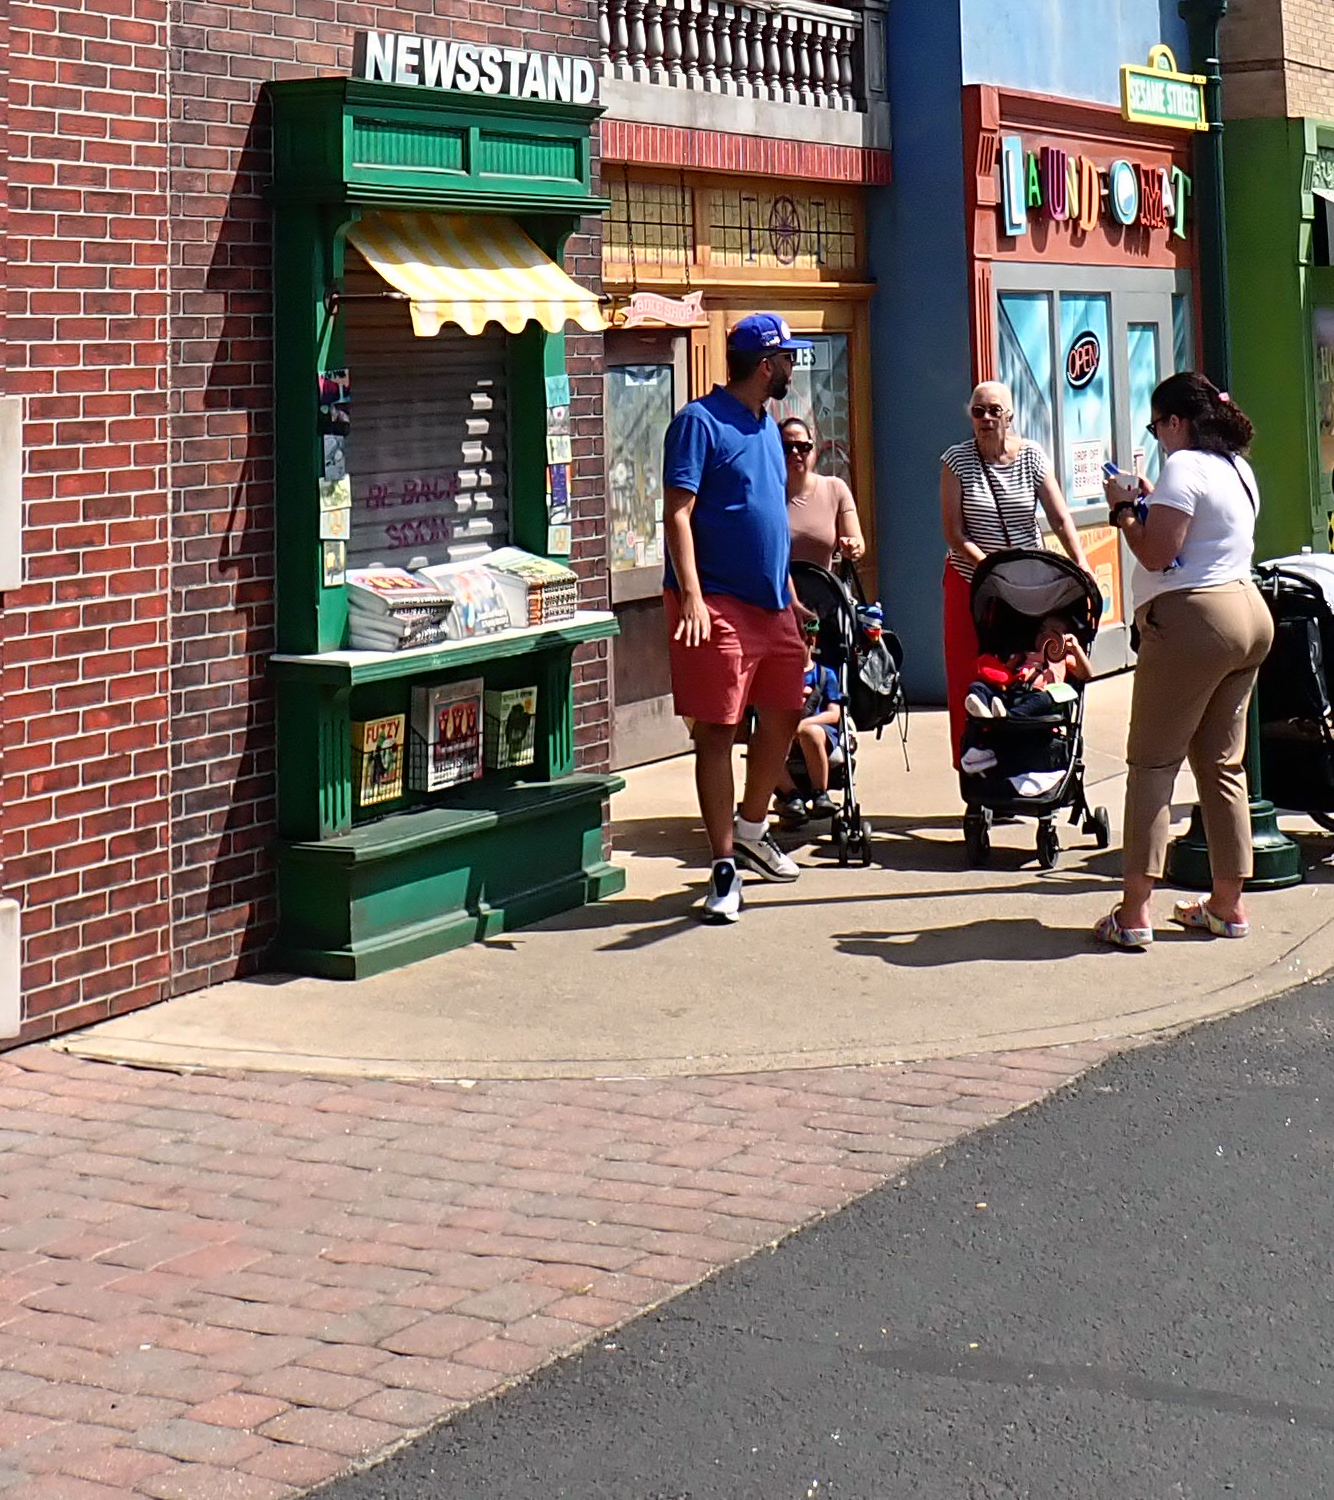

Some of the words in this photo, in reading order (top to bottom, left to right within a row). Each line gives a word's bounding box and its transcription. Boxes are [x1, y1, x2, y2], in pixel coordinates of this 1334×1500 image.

[365, 31, 595, 105] NEWSSTAND
[1130, 75, 1165, 113] SESAME
[1166, 83, 1199, 119] STREET
[635, 298, 664, 315] BIKE
[663, 302, 693, 321] SHOP
[1068, 344, 1098, 379] OPEN
[365, 484, 394, 509] BE
[401, 471, 460, 505] BACK
[385, 514, 450, 550] SOON
